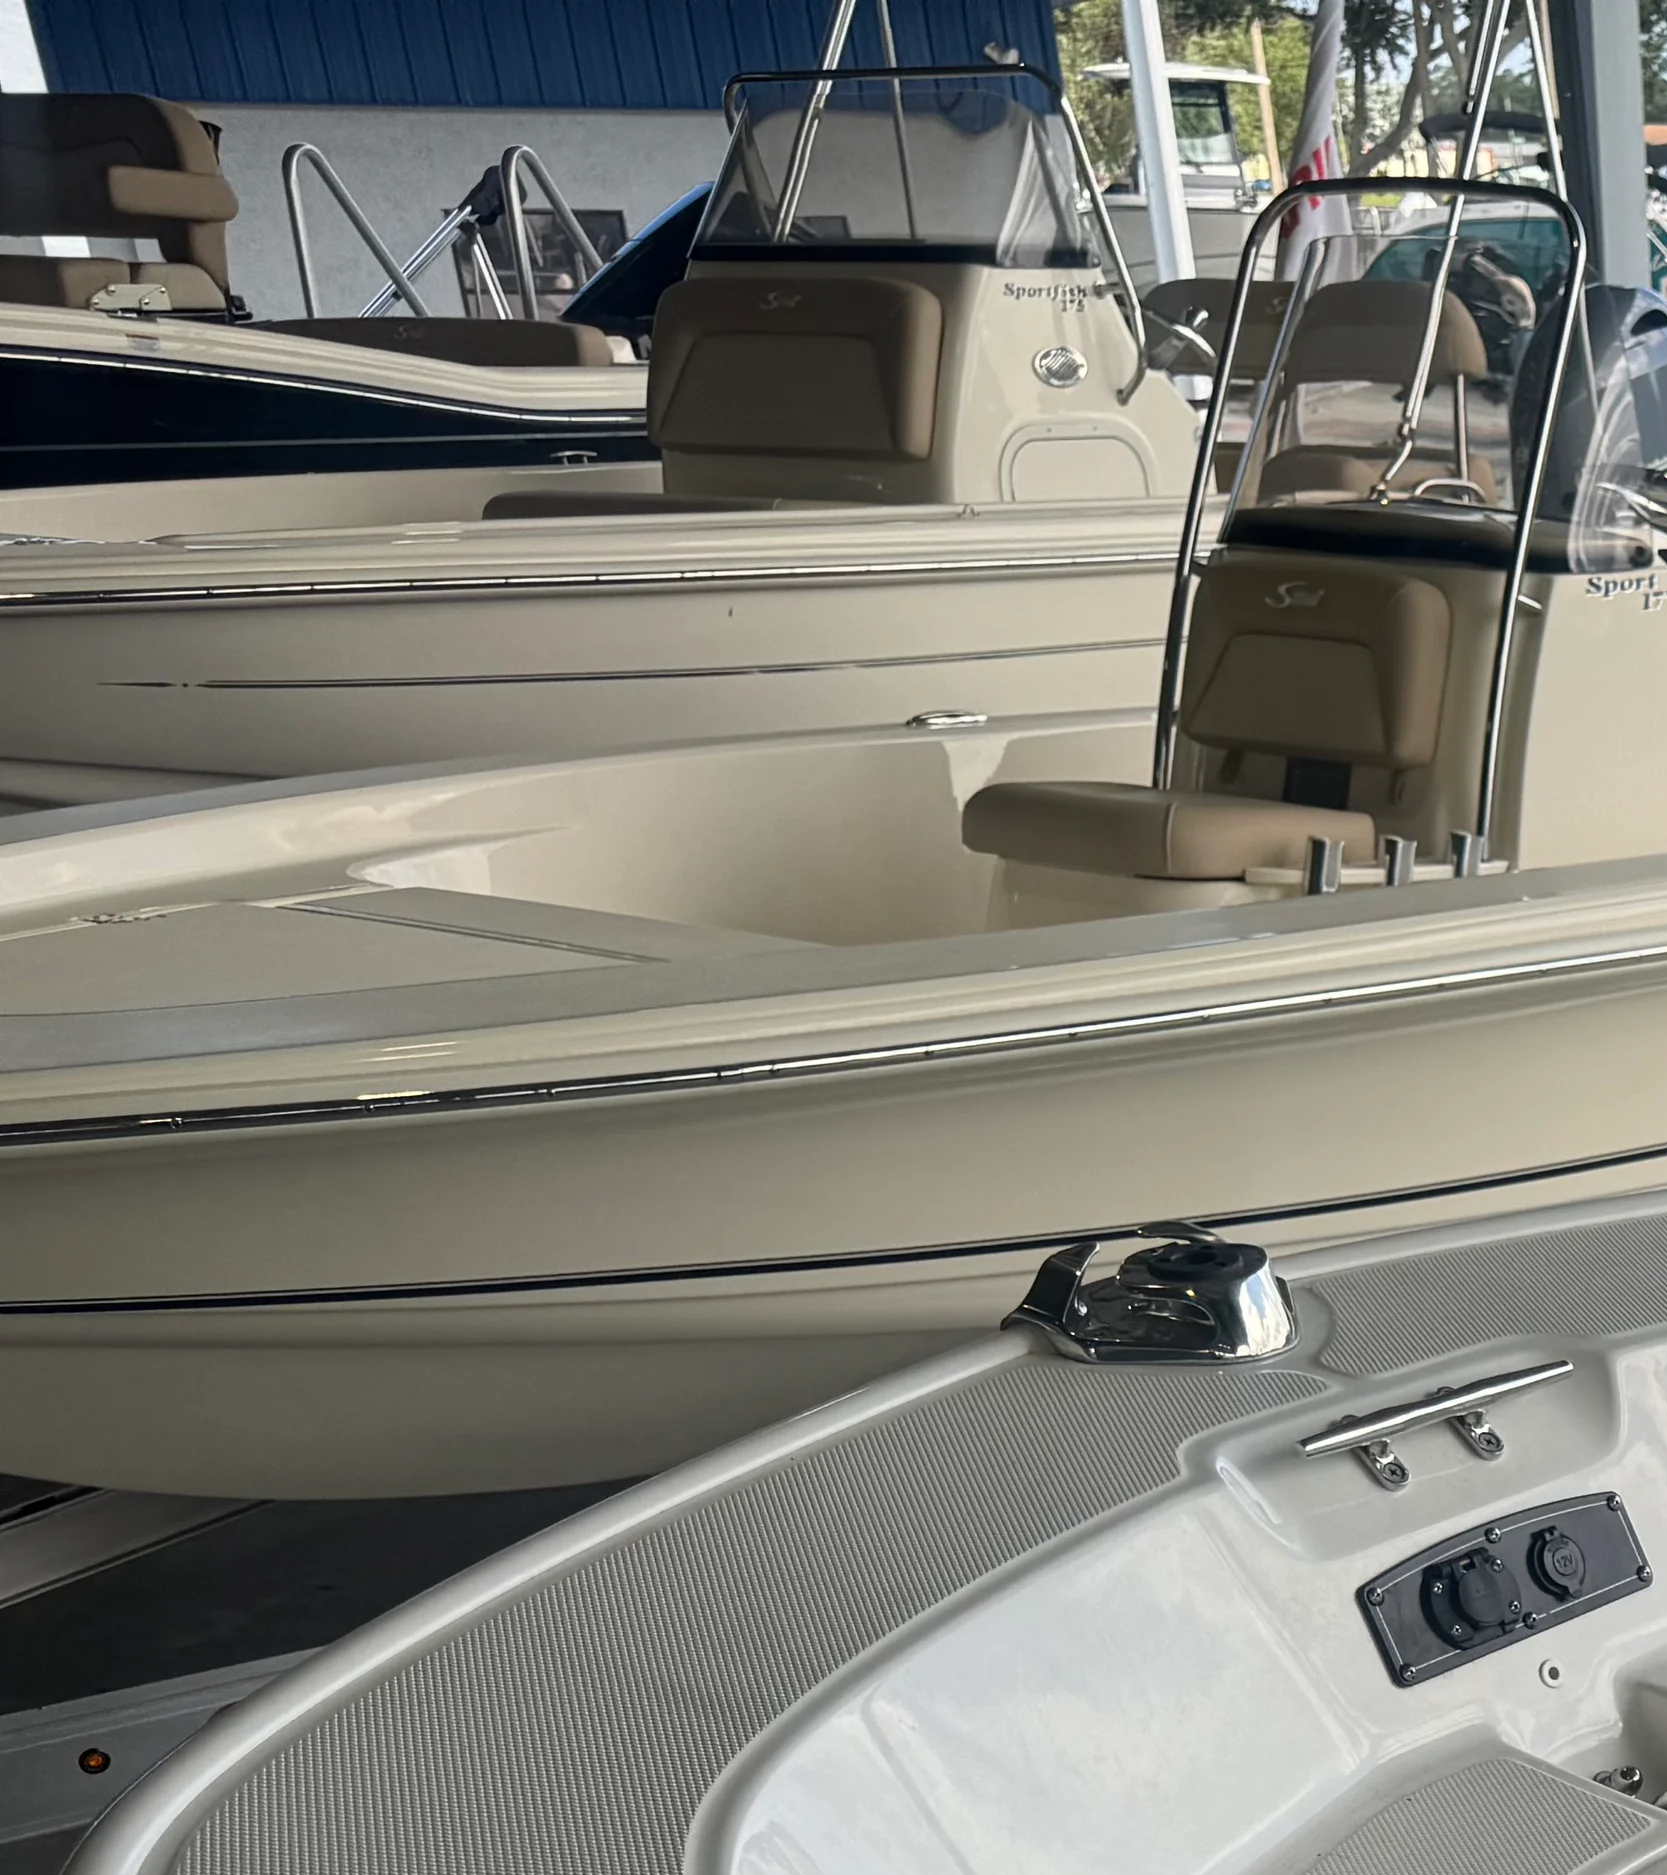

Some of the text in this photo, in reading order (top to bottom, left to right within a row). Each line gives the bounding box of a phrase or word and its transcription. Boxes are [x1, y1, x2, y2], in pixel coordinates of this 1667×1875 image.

[1003, 282, 1088, 301] Sportfish
[1586, 573, 1656, 598] Sport
[1556, 1553, 1573, 1569] 12V
